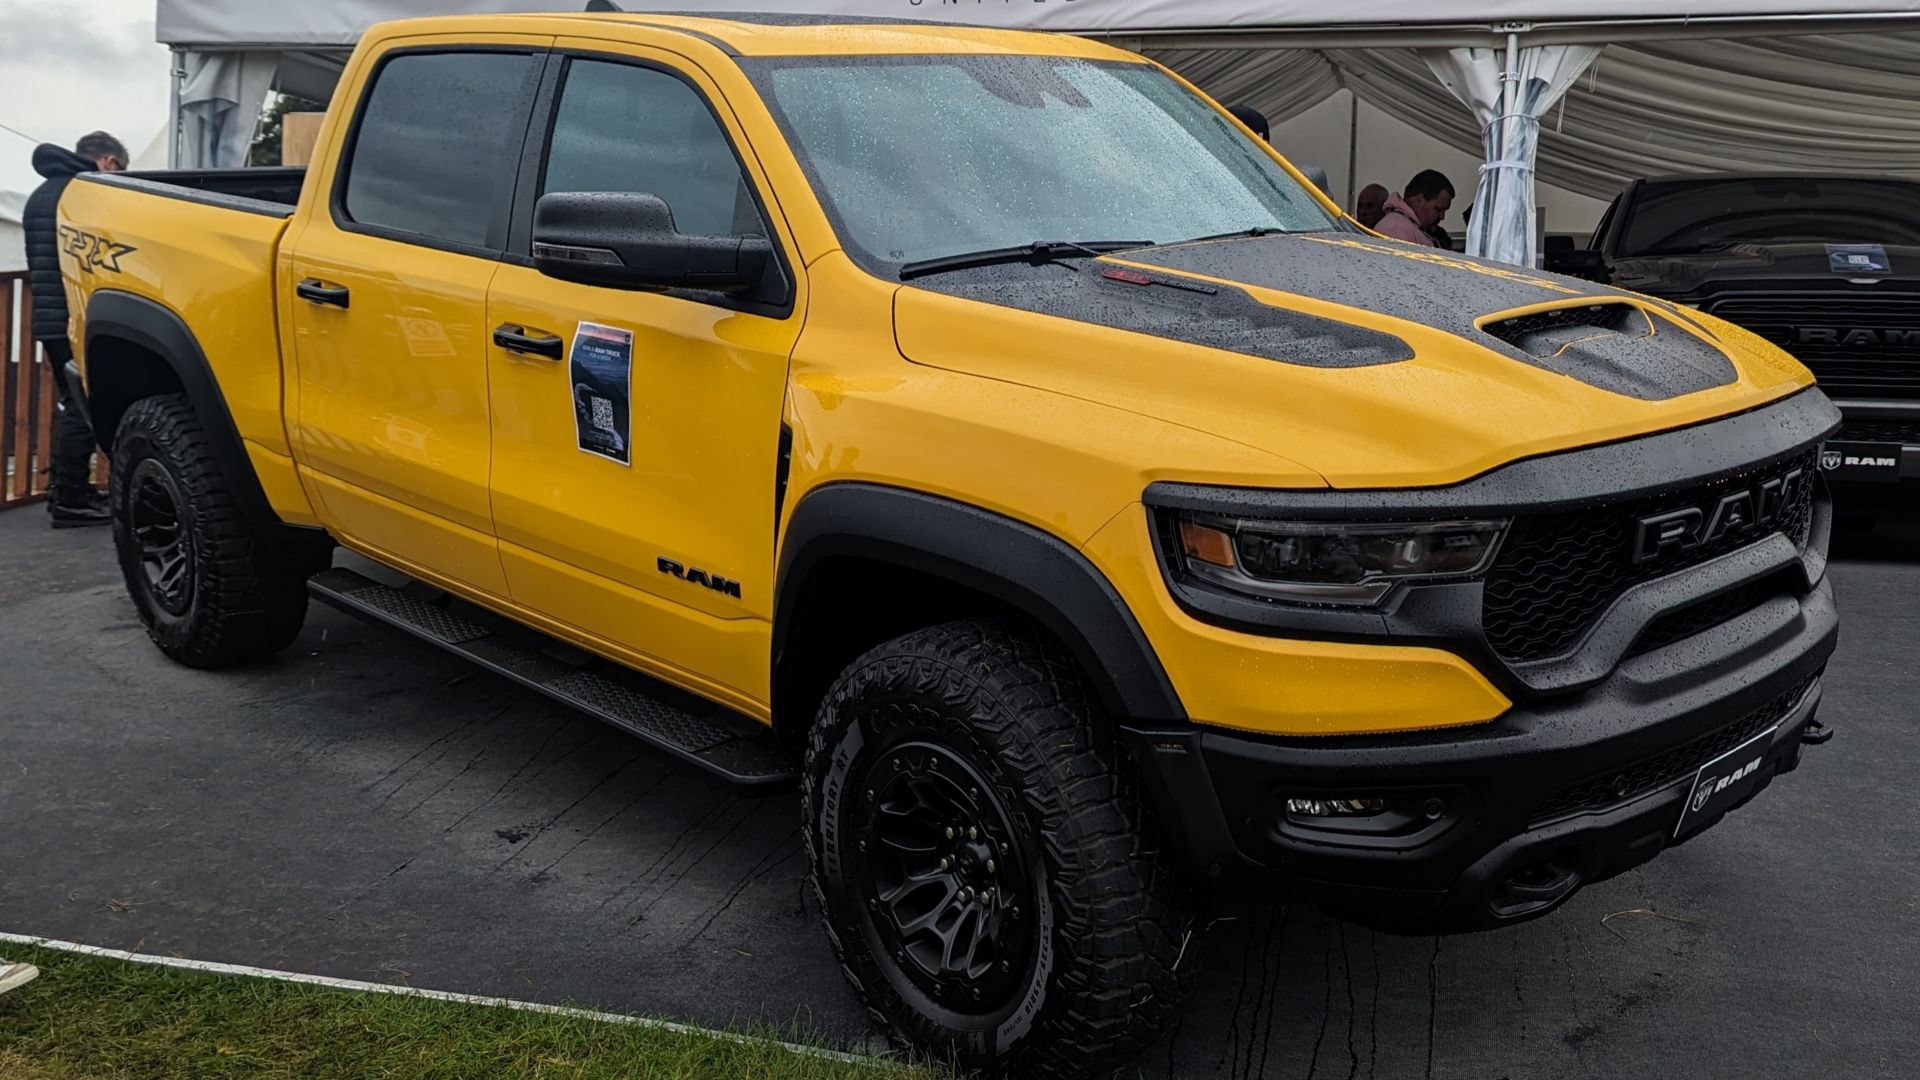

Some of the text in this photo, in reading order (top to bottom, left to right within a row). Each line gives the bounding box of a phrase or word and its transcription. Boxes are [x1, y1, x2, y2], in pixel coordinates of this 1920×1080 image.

[59, 224, 138, 274] TRX
[1845, 456, 1896, 467] RAM
[1632, 467, 1802, 565] RAM
[657, 555, 741, 599] RAM
[1714, 756, 1762, 793] RAM
[826, 749, 848, 874] TERRITORY RT
